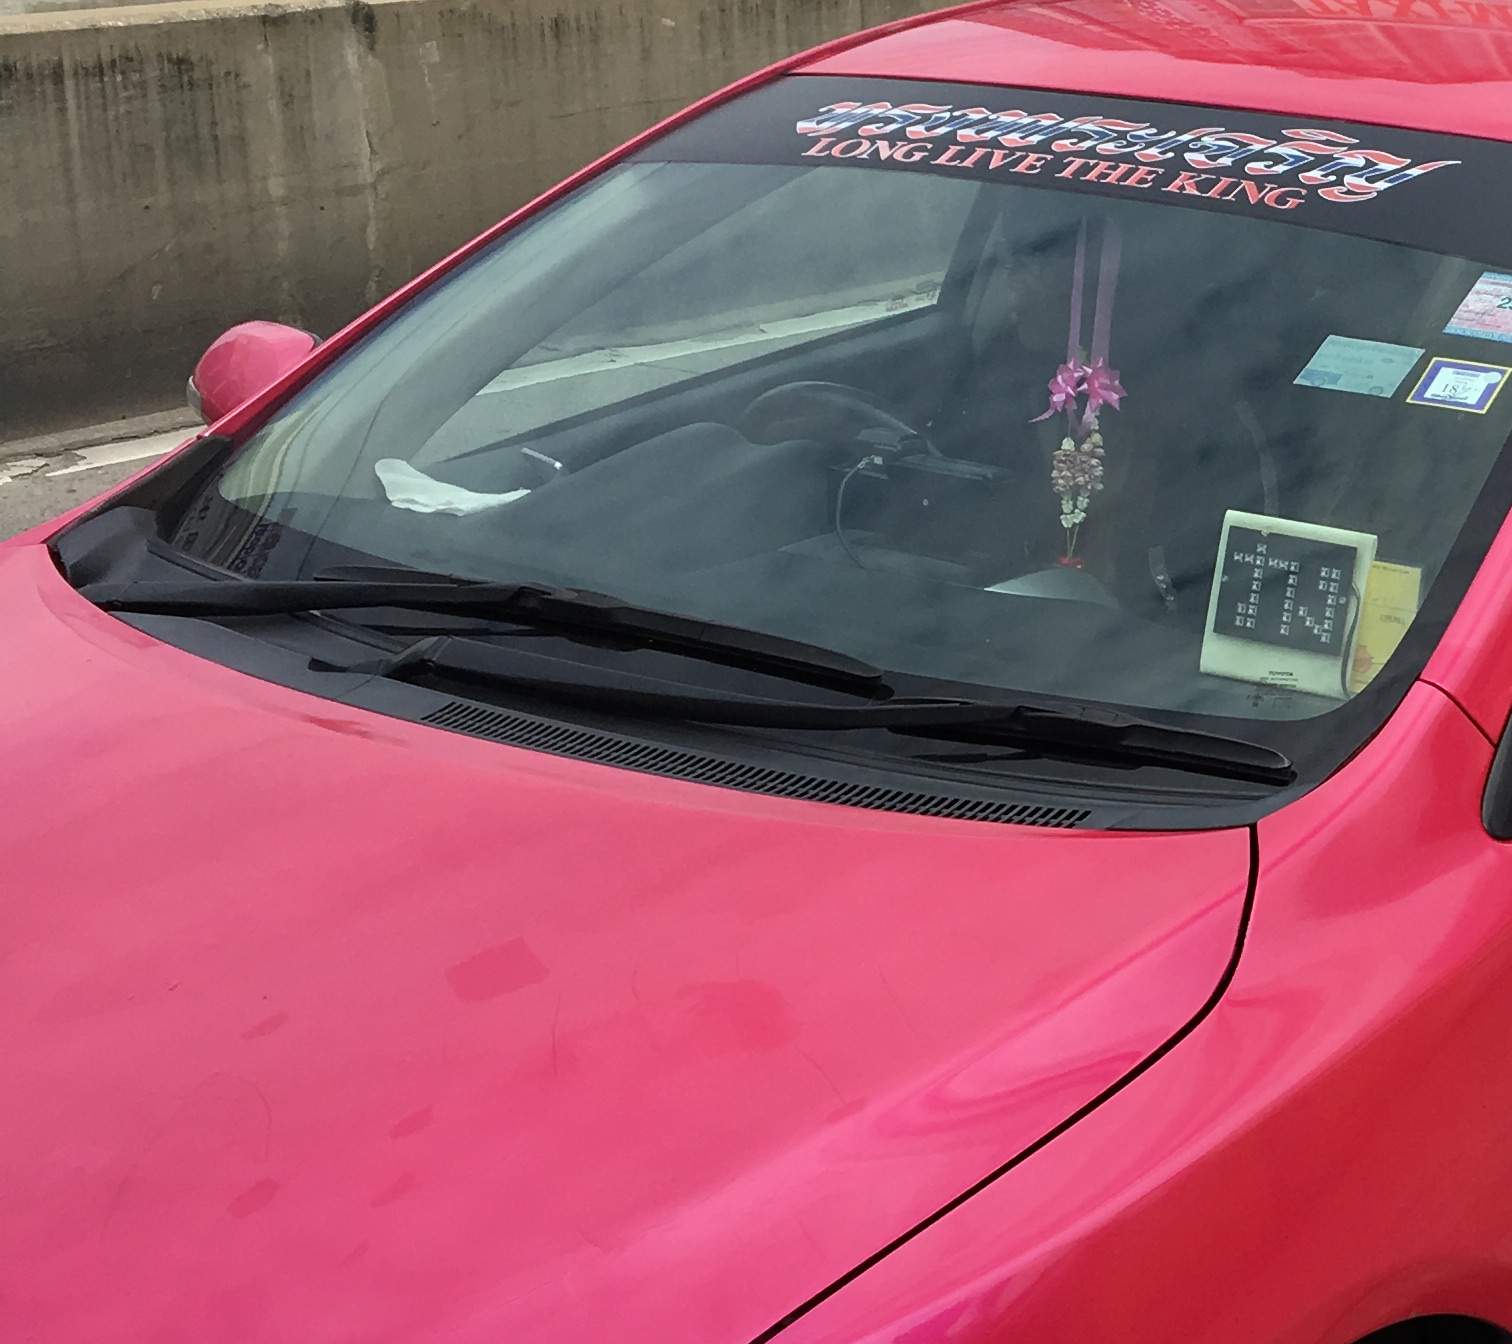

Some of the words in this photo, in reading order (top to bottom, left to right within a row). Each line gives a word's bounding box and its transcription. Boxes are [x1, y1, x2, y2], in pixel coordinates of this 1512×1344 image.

[796, 101, 1462, 203] ทรงพระเจริญ
[801, 137, 934, 163] LONG
[930, 145, 1054, 174] LIVE
[1054, 155, 1165, 189] THE
[1161, 170, 1308, 210] KING
